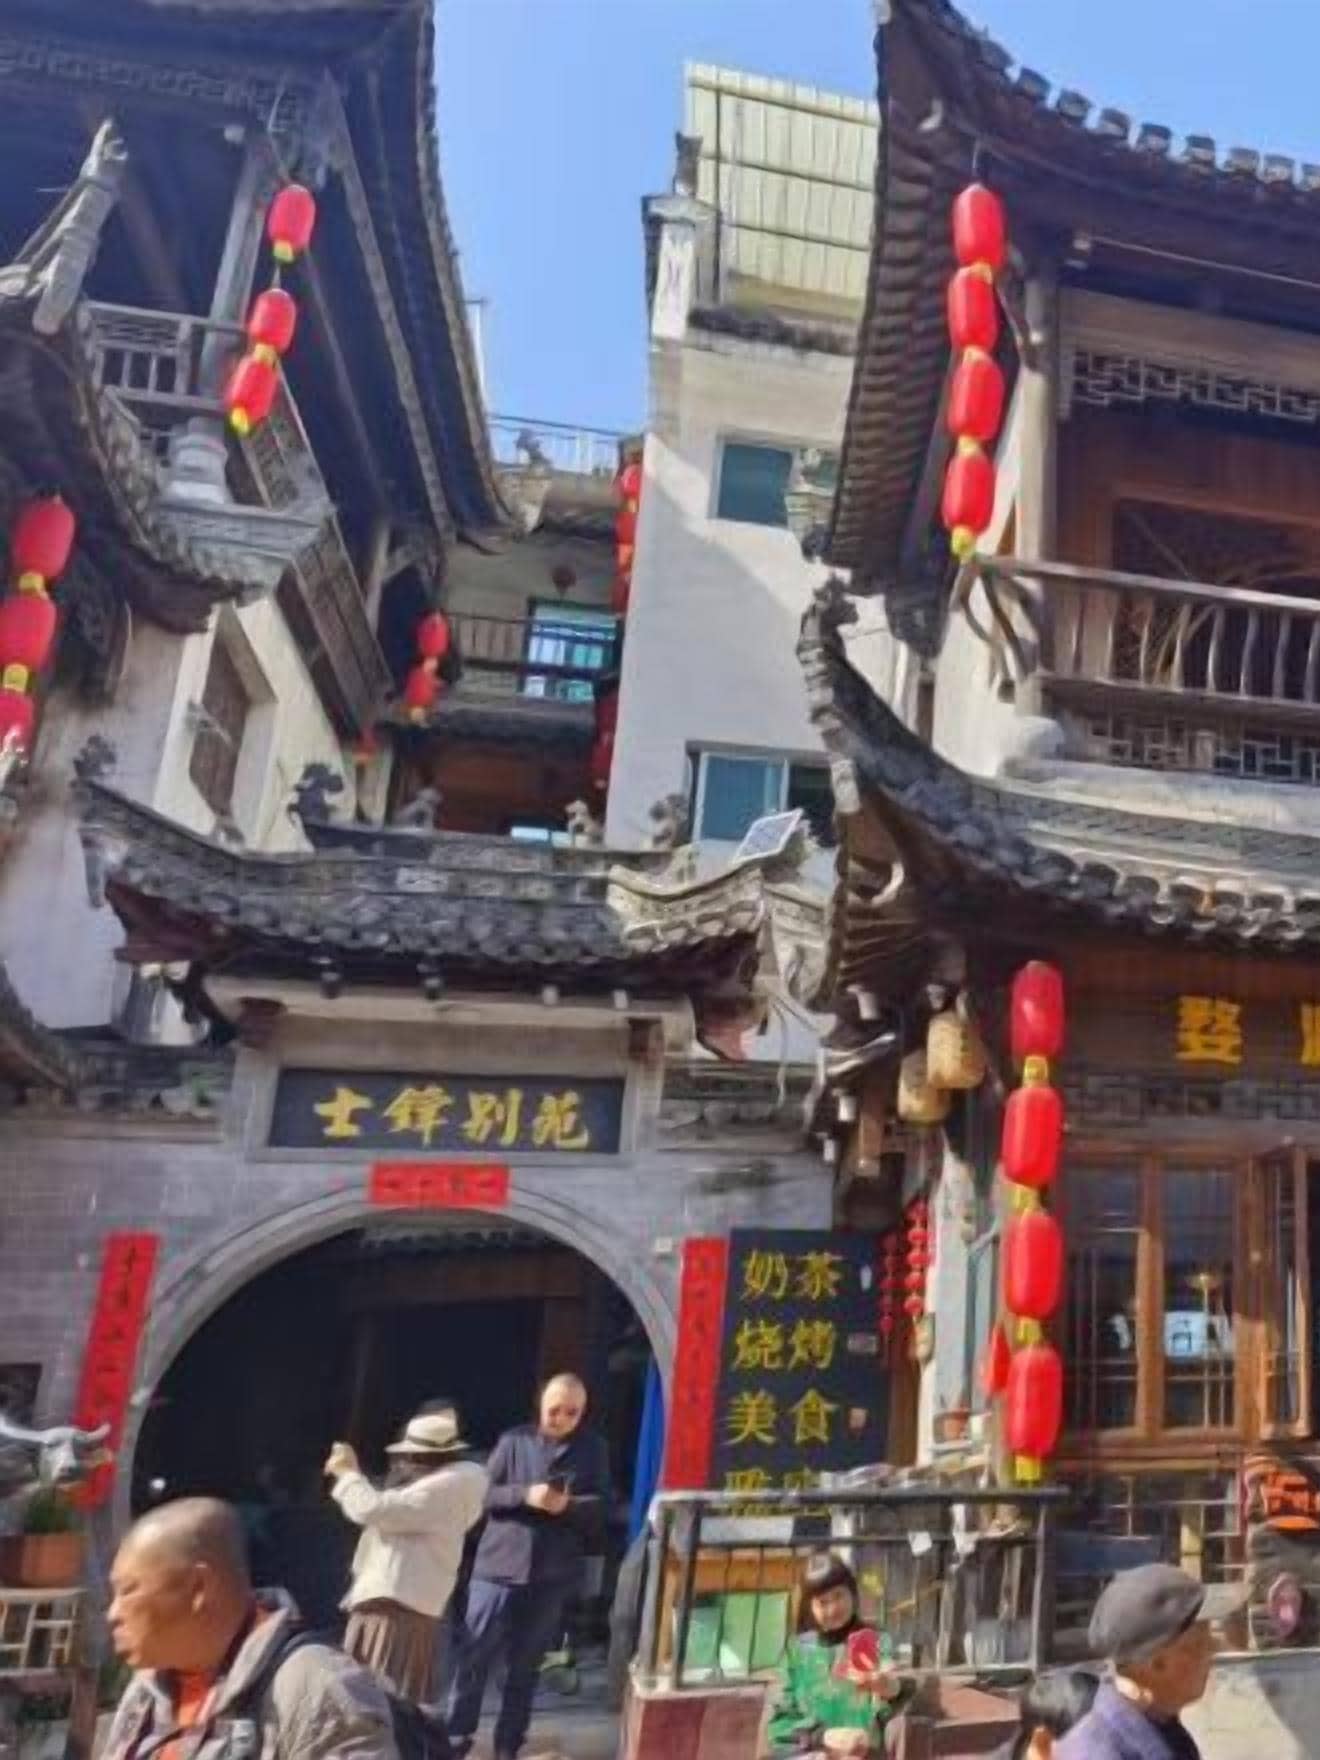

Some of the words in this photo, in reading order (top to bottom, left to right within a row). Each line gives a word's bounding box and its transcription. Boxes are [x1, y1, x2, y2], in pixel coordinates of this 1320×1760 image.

[740, 1249, 842, 1301] 奶茶
[732, 1318, 837, 1369] 烧烤
[721, 1388, 836, 1446] 美食
